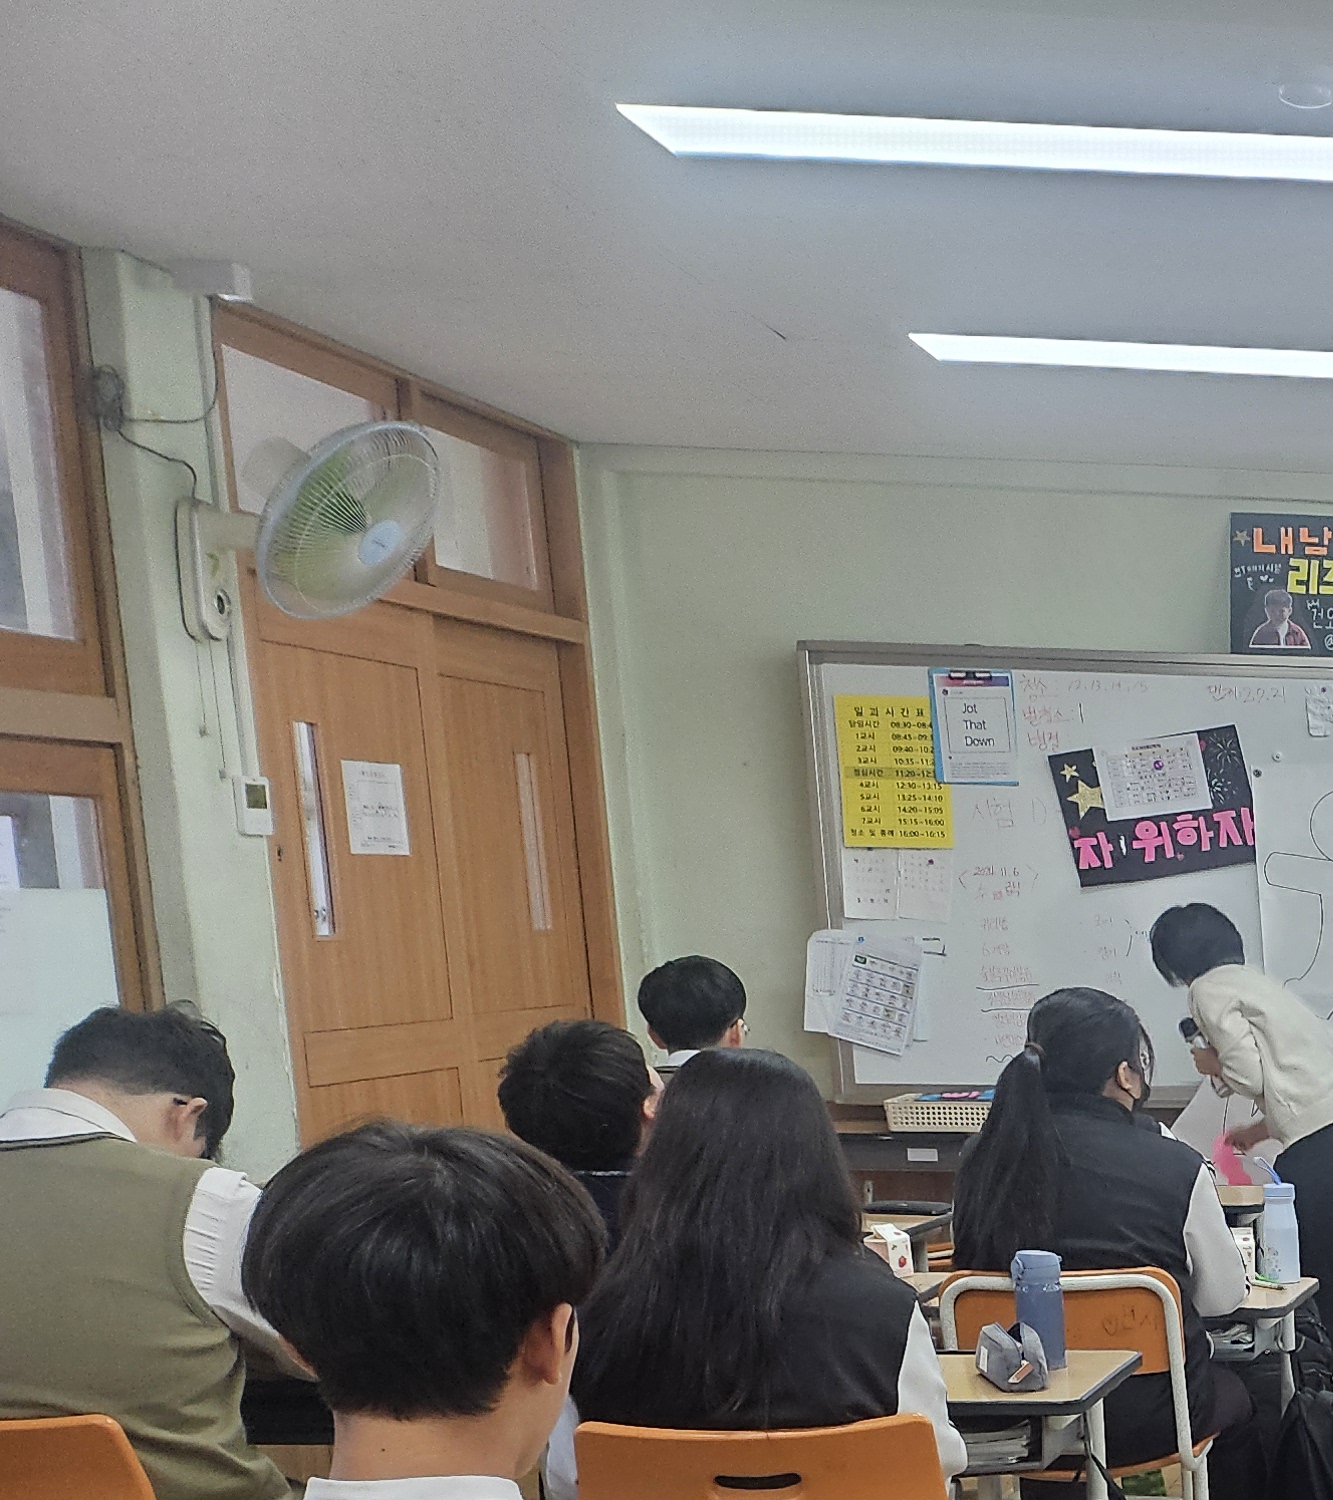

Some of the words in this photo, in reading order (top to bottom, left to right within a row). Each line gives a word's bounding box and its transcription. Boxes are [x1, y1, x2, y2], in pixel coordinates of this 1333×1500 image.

[962, 703, 977, 714] Jot
[963, 720, 987, 730] That
[965, 736, 994, 746] Down
